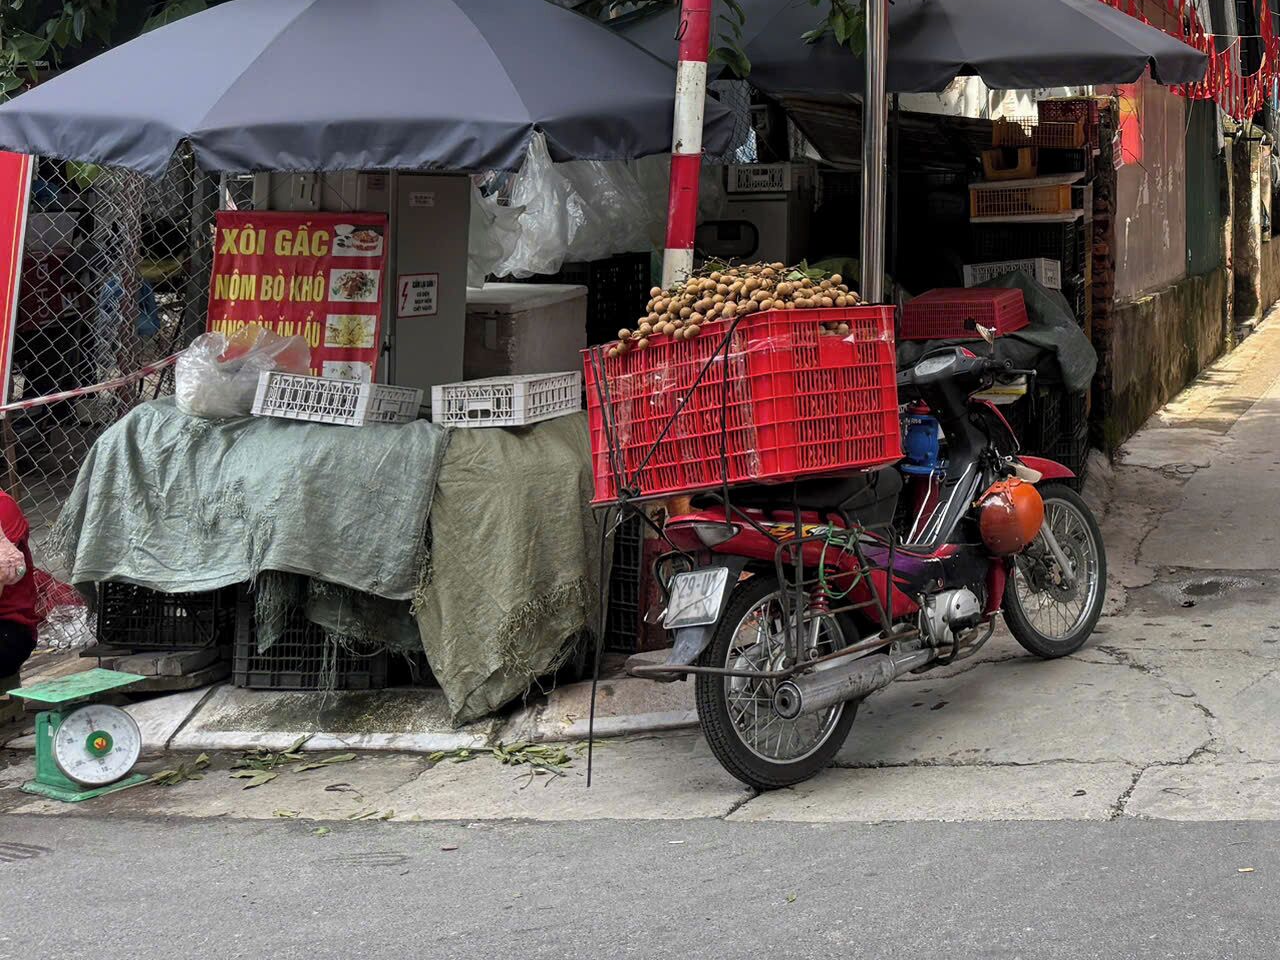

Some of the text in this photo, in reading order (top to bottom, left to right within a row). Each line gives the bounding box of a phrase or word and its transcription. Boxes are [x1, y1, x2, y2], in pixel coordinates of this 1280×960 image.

[219, 221, 330, 257] XÔI GẤC
[214, 268, 325, 307] NỘM BÒ KHÔ
